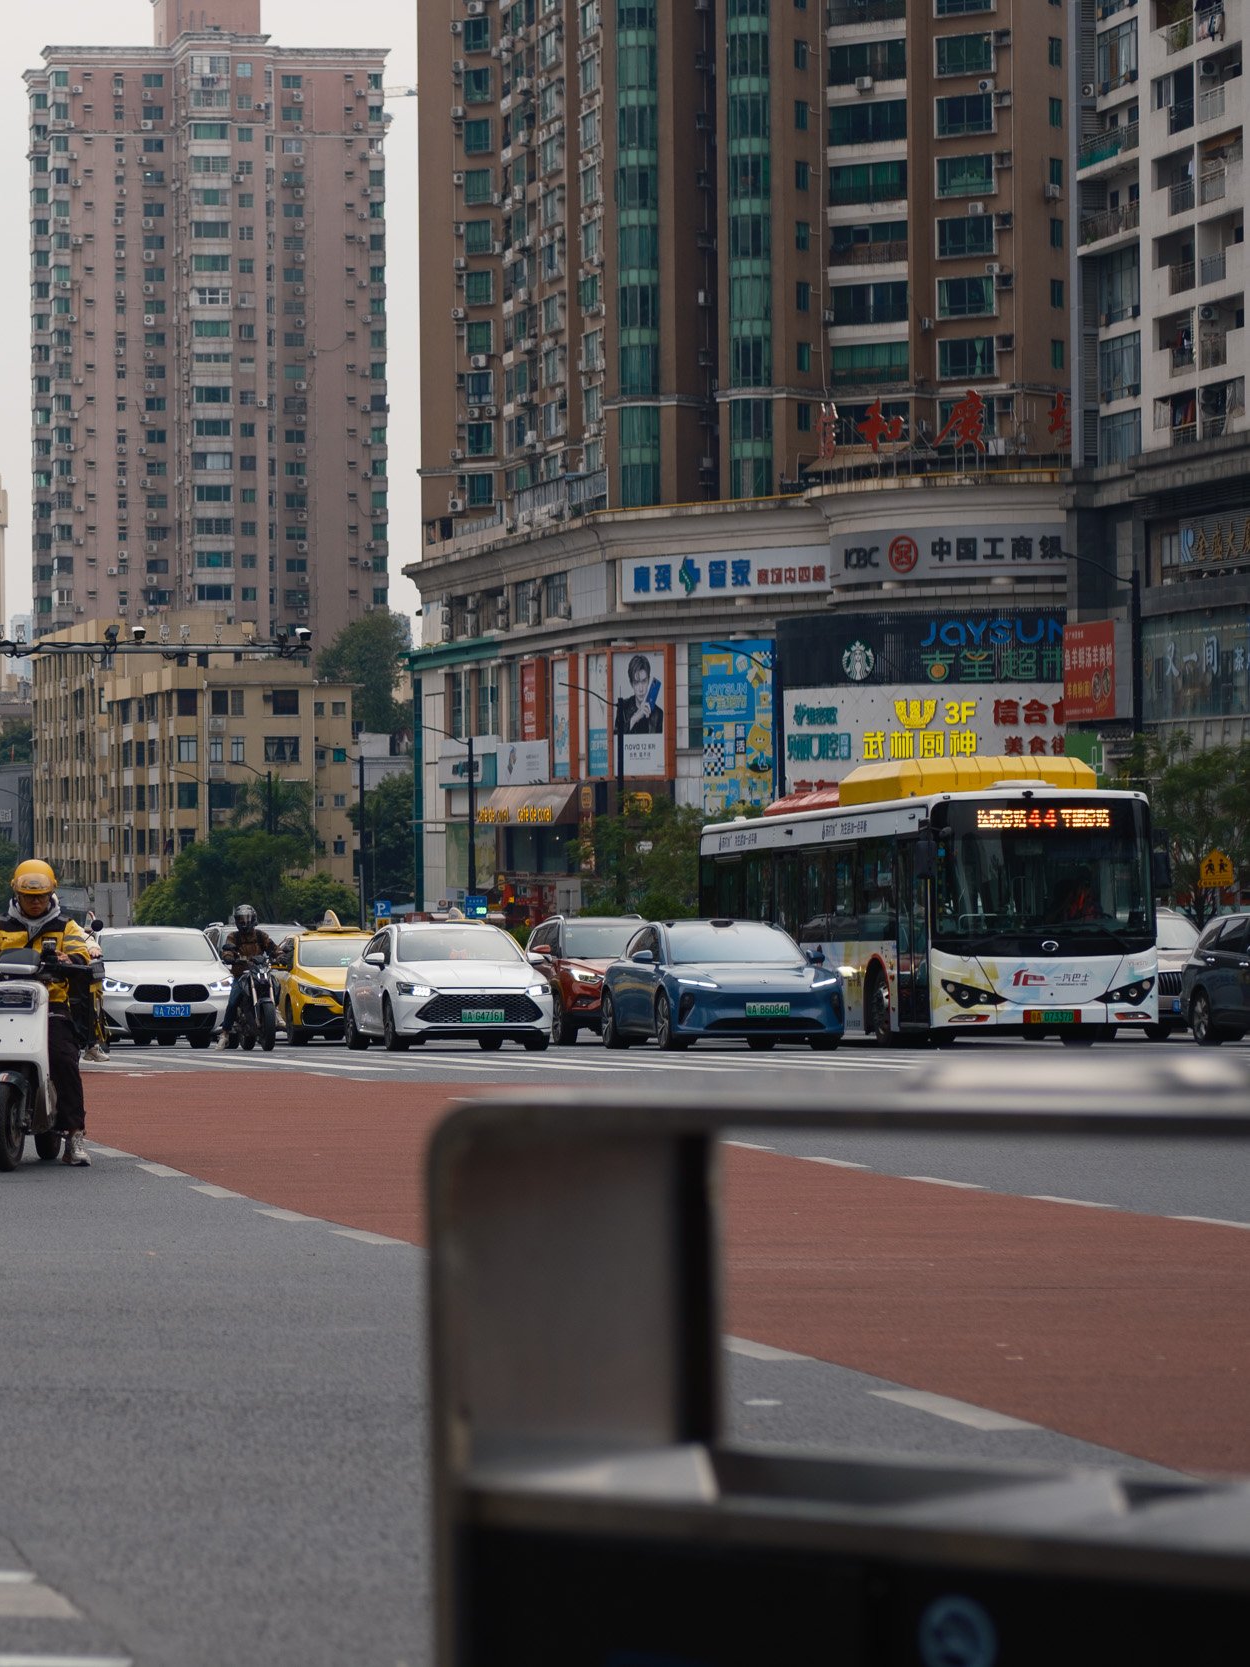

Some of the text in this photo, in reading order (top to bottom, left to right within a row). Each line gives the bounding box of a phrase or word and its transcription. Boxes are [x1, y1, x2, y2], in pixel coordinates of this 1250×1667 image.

[844, 547, 879, 569] ICBC
[944, 701, 977, 725] 3F
[862, 729, 978, 760] 武林厨神
[1028, 809, 1057, 828] 44
[376, 903, 386, 916] P
